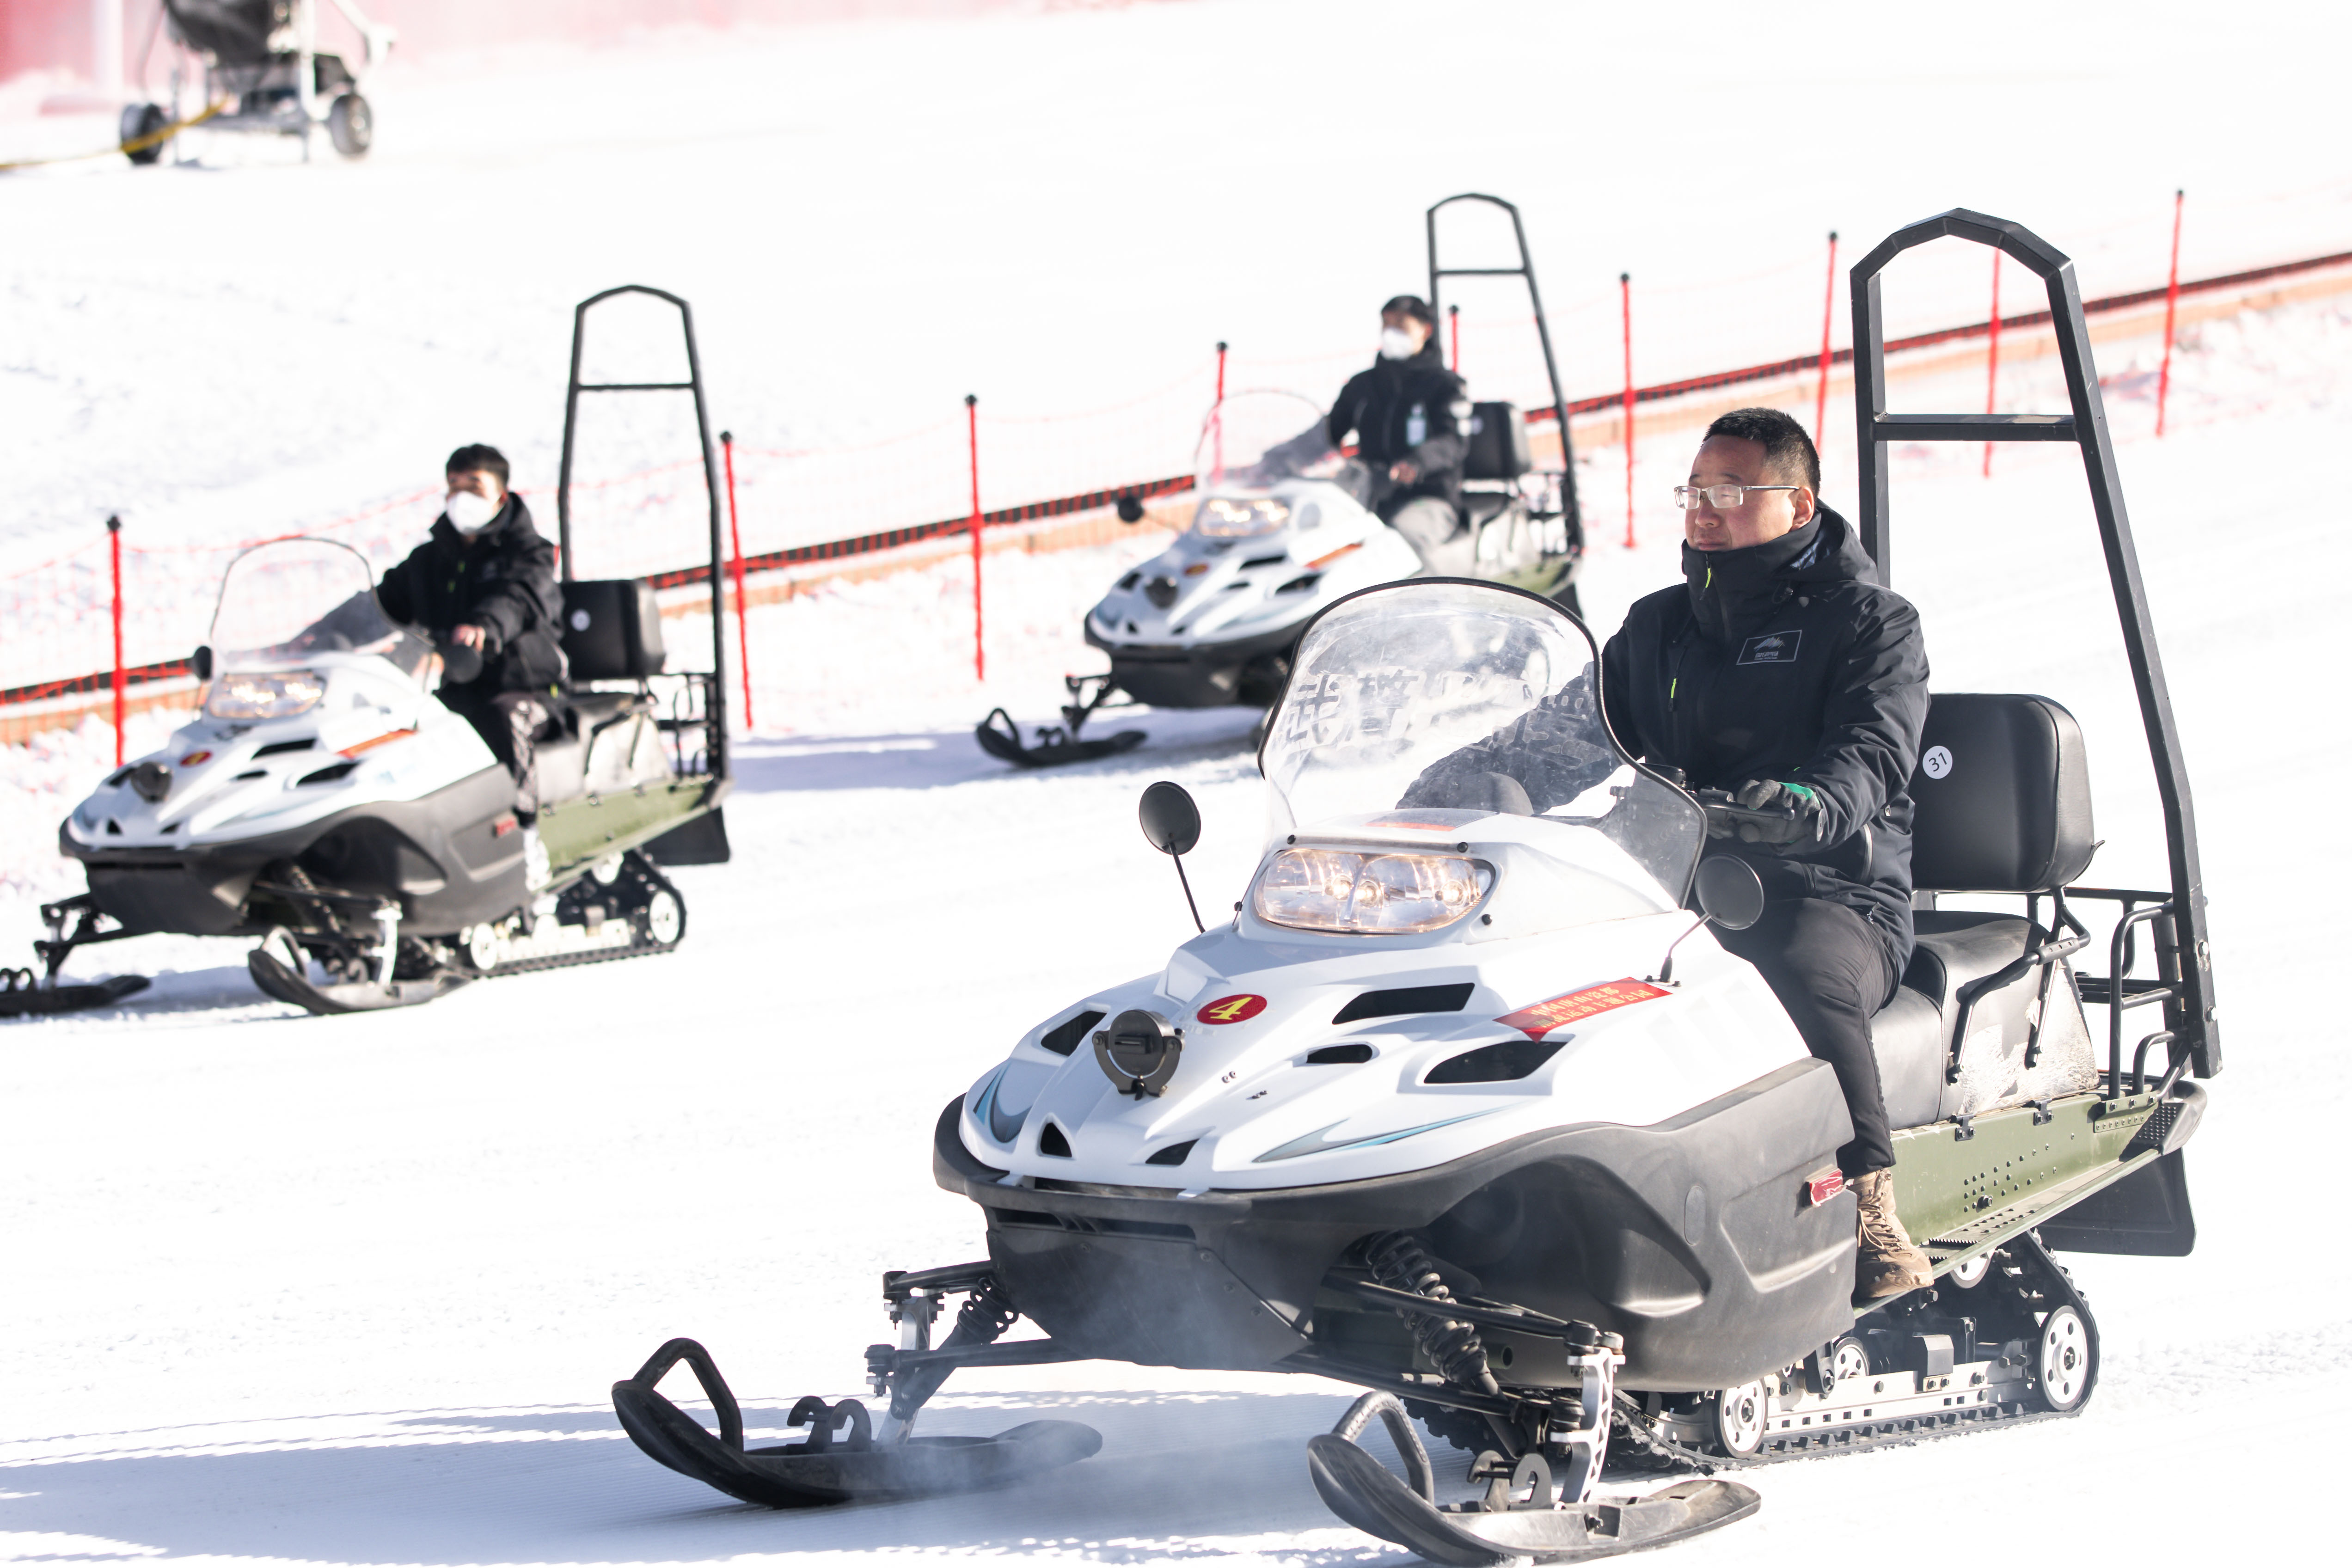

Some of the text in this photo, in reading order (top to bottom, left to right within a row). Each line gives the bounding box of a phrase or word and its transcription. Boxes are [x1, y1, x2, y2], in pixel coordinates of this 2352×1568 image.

[1929, 752, 1947, 772] 31
[1209, 997, 1253, 1020] 4
[1531, 986, 1619, 1017] 中国唐山瓷都
[1533, 989, 1654, 1029] 潮流运动主题公园
